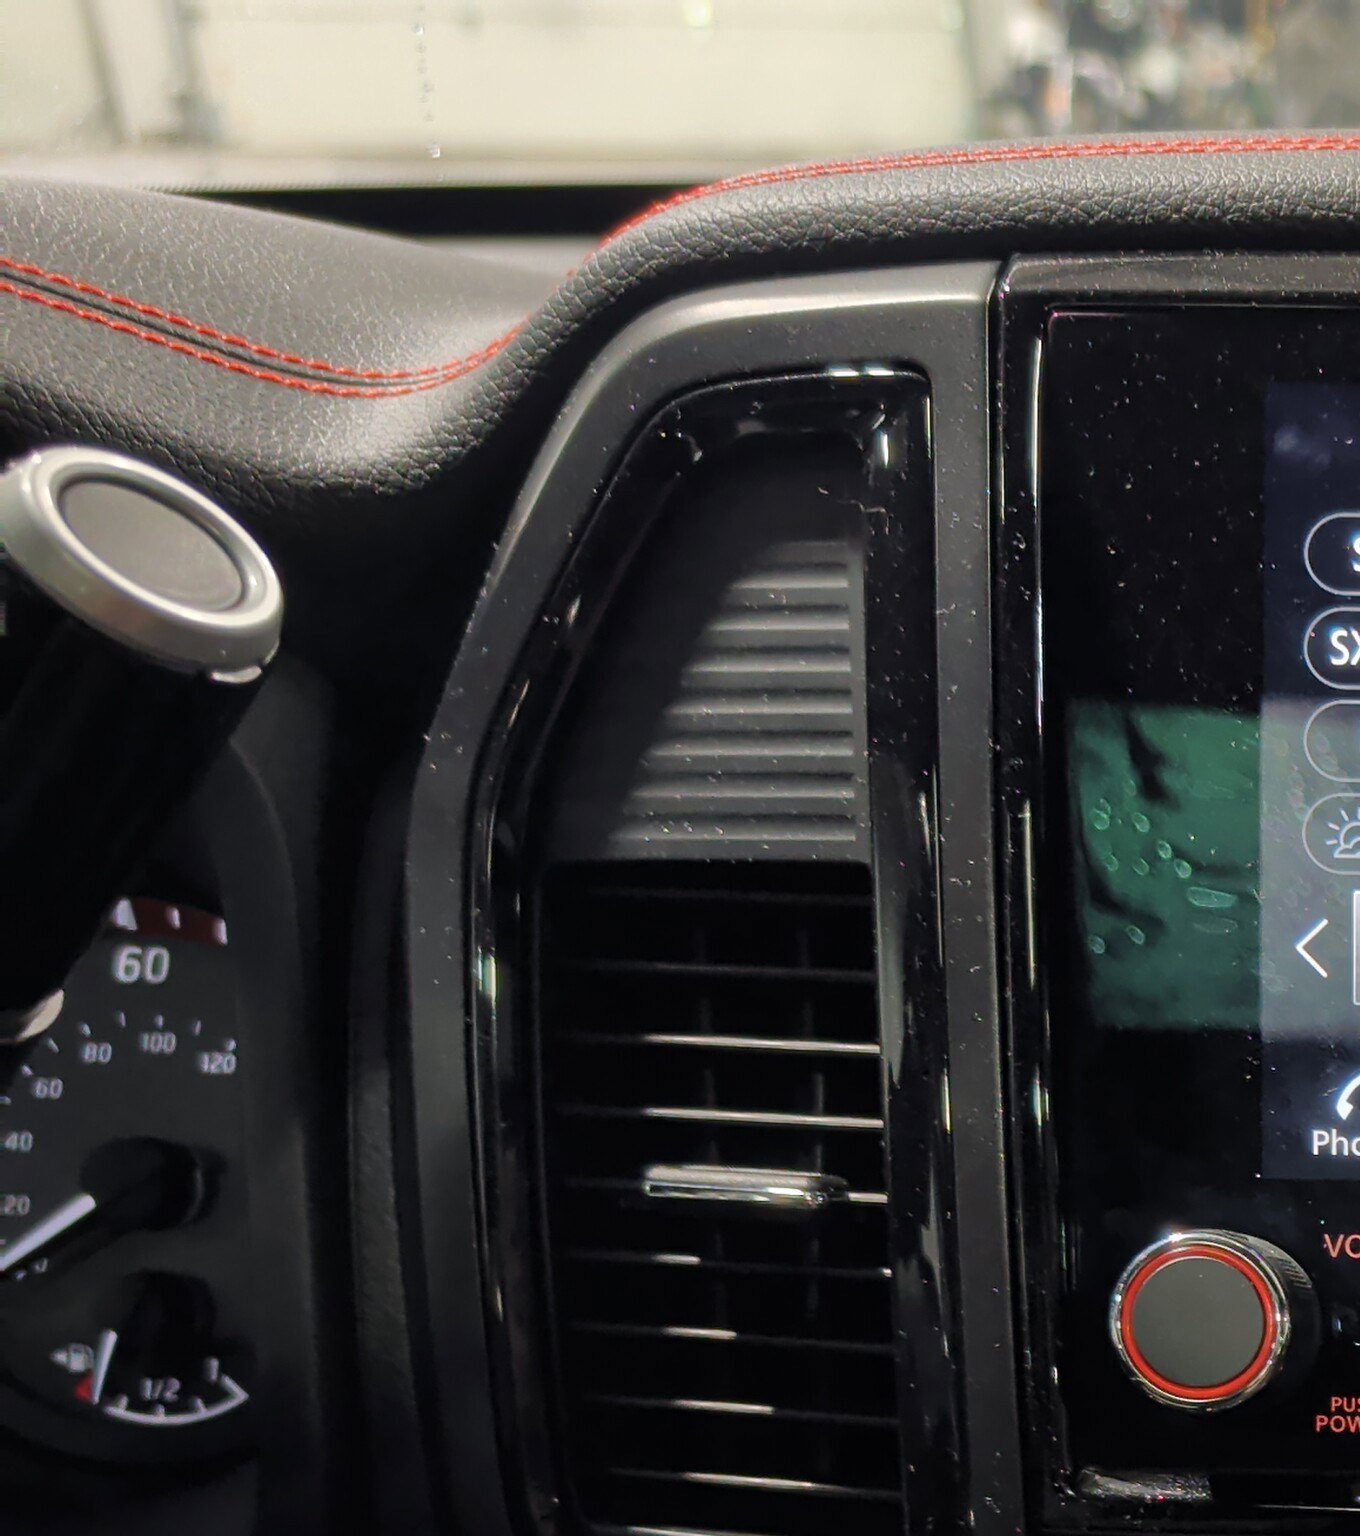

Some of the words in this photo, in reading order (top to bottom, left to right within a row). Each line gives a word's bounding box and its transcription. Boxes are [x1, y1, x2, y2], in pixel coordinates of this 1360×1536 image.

[113, 944, 171, 985] 60
[81, 1042, 113, 1065] 80
[139, 1032, 177, 1055] 100
[34, 1077, 64, 1100] 60
[4, 1130, 34, 1151] 40
